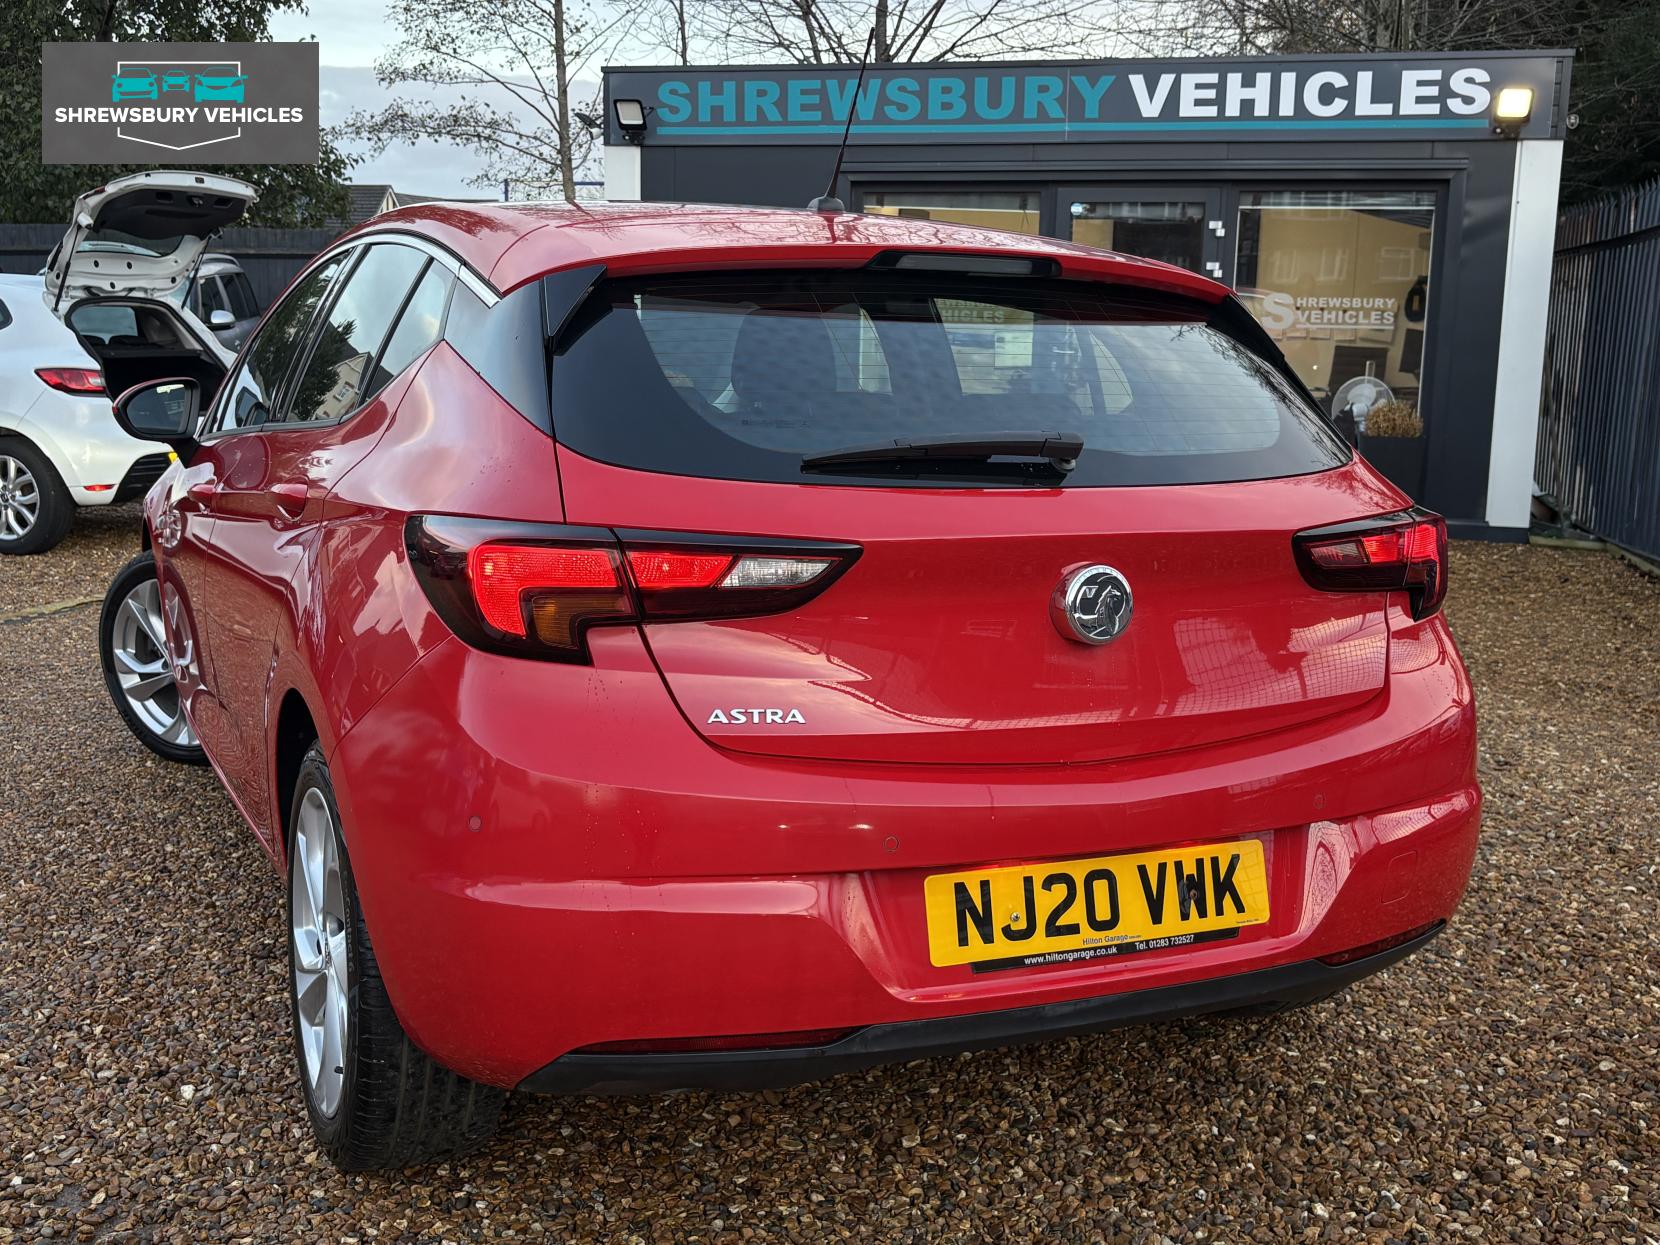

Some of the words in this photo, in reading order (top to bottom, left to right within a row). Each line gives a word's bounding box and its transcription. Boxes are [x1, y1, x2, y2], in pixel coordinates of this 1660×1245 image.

[656, 75, 1117, 122] SHREWSBURY
[1127, 67, 1491, 117] VEHICLES
[1296, 310, 1395, 324] VEHICLES
[707, 708, 806, 724] ASTRA
[953, 868, 1121, 947] NJ20
[1136, 853, 1246, 926] VWK
[1082, 936, 1103, 946] Hilton
[1104, 934, 1129, 943] Garage
[1135, 942, 1148, 951] Tel.
[1149, 938, 1169, 949] 01283
[1170, 934, 1195, 946] 732527
[1024, 945, 1118, 965] www.hiltongarage.co.uk
